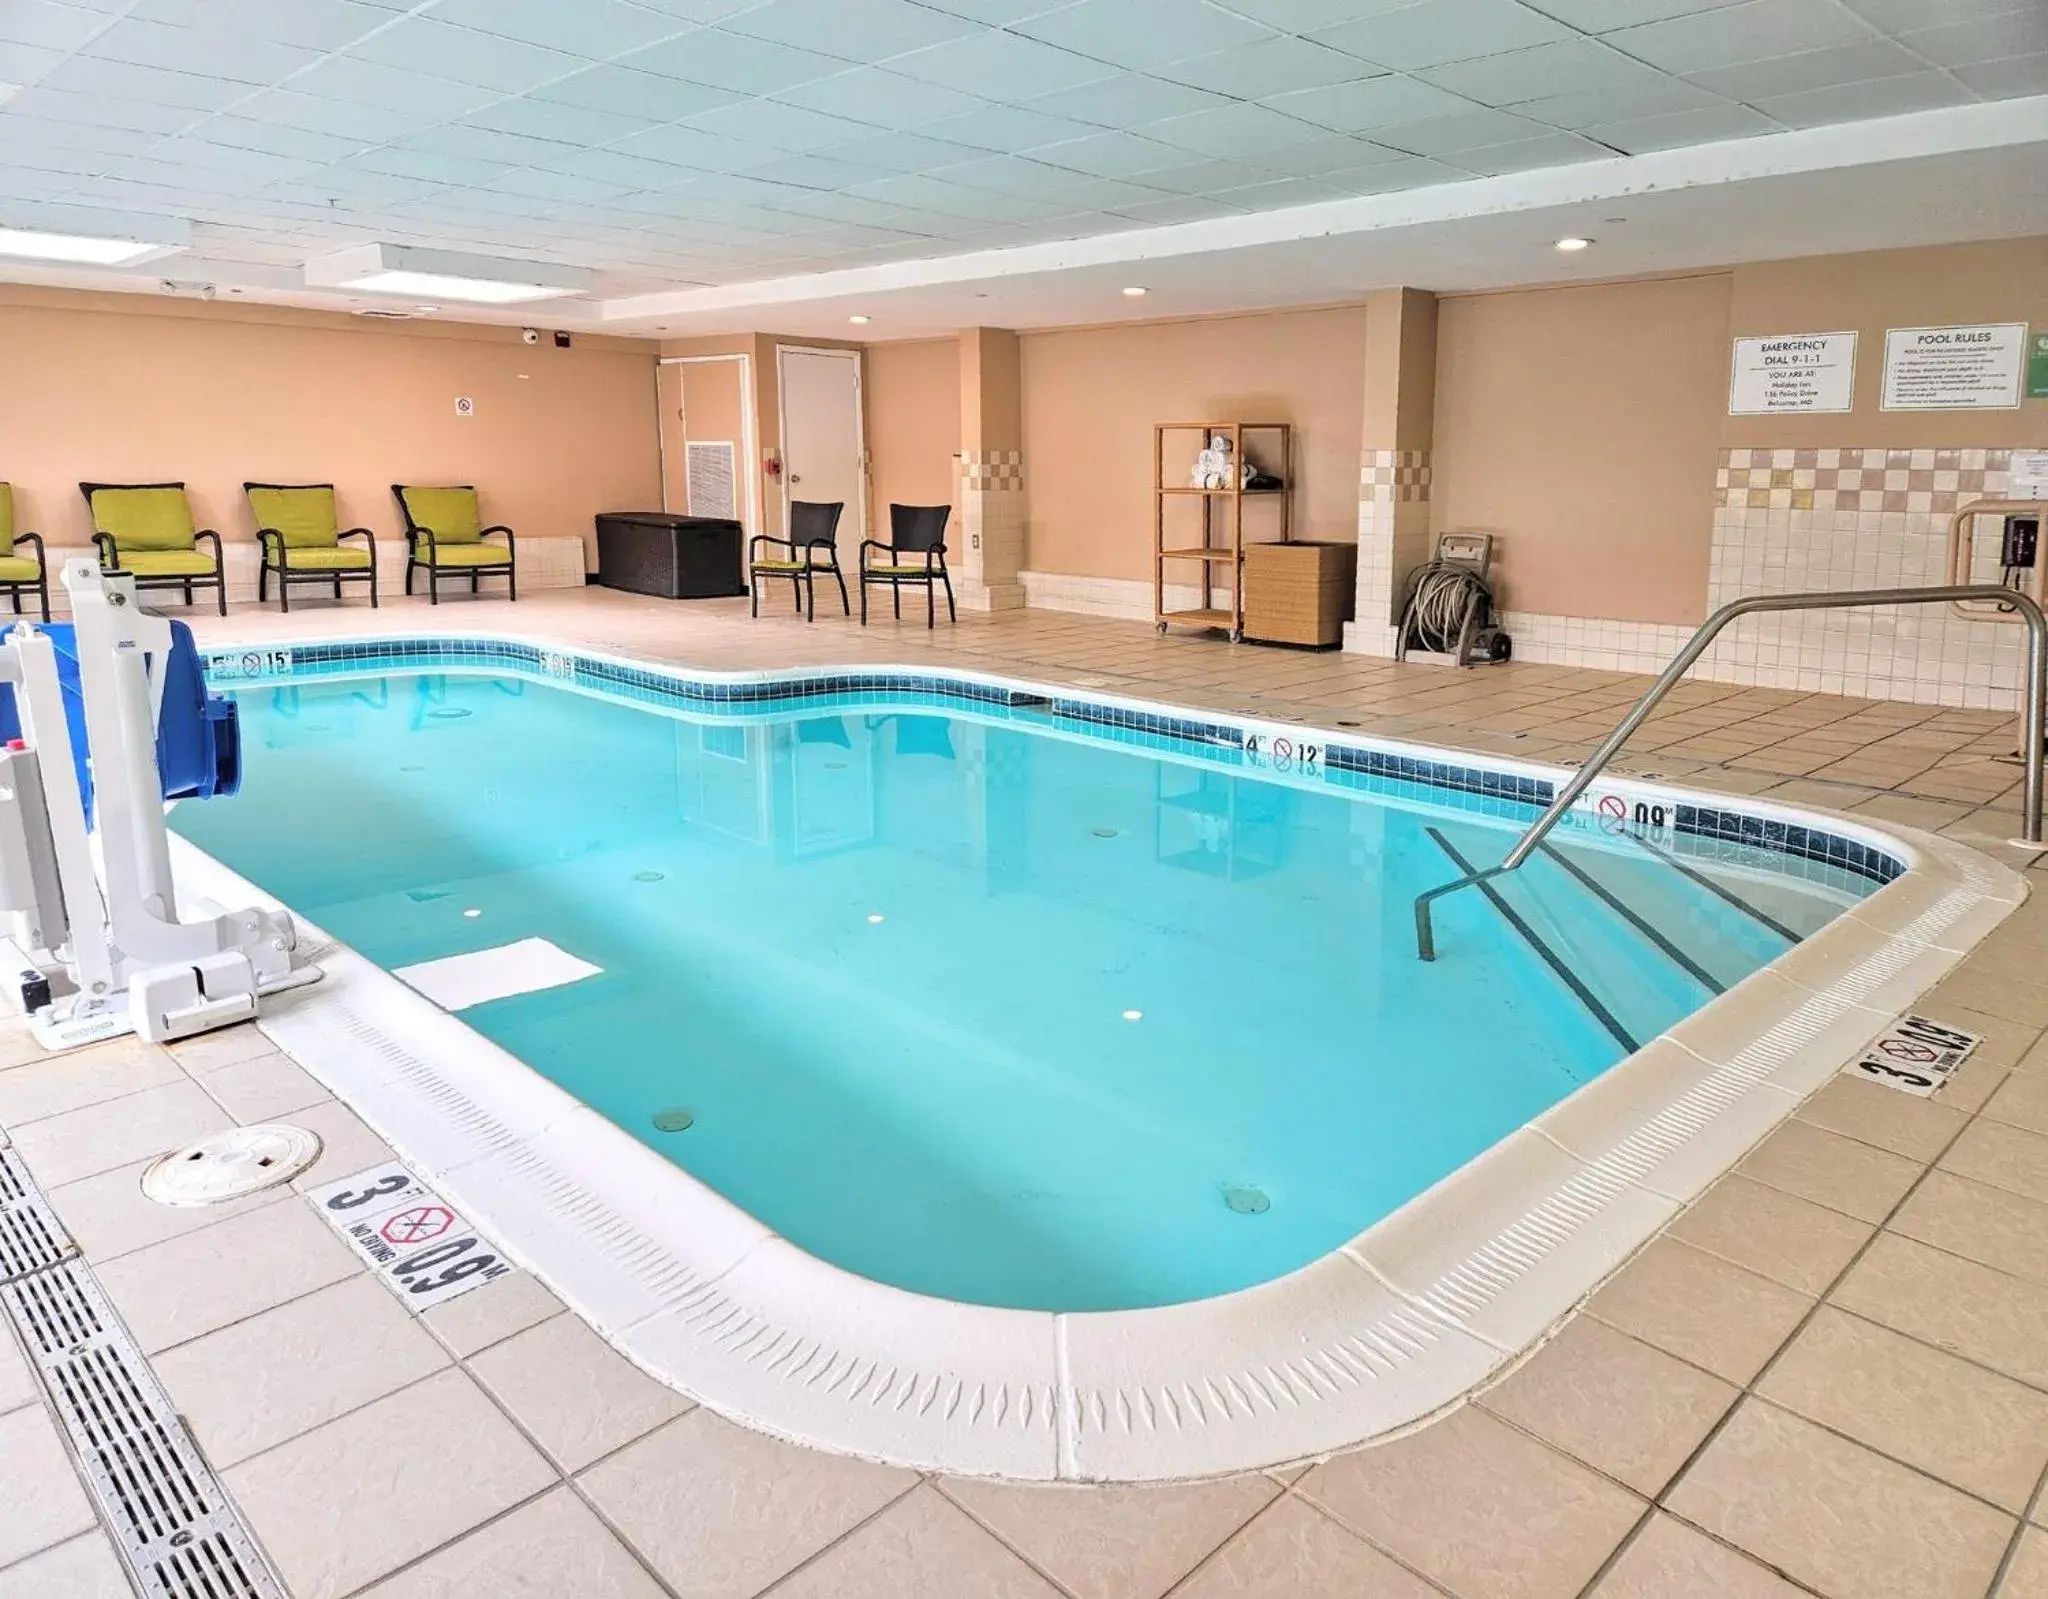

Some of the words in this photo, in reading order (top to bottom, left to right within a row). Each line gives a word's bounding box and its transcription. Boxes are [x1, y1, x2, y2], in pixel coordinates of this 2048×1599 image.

[1761, 340, 1827, 352] EMERGENCY
[1918, 335, 1952, 344] POOL
[1955, 333, 1992, 343] RULES
[1765, 356, 1788, 365] DIAL
[1791, 354, 1820, 364] 9-1-1
[1246, 735, 1258, 751] 4
[1859, 1061, 1933, 1087] 3
[327, 1175, 410, 1210] 3
[350, 1222, 366, 1238] NO
[359, 1232, 397, 1263] DIVING
[391, 1237, 496, 1294] 0.9
[480, 1262, 510, 1281] M
